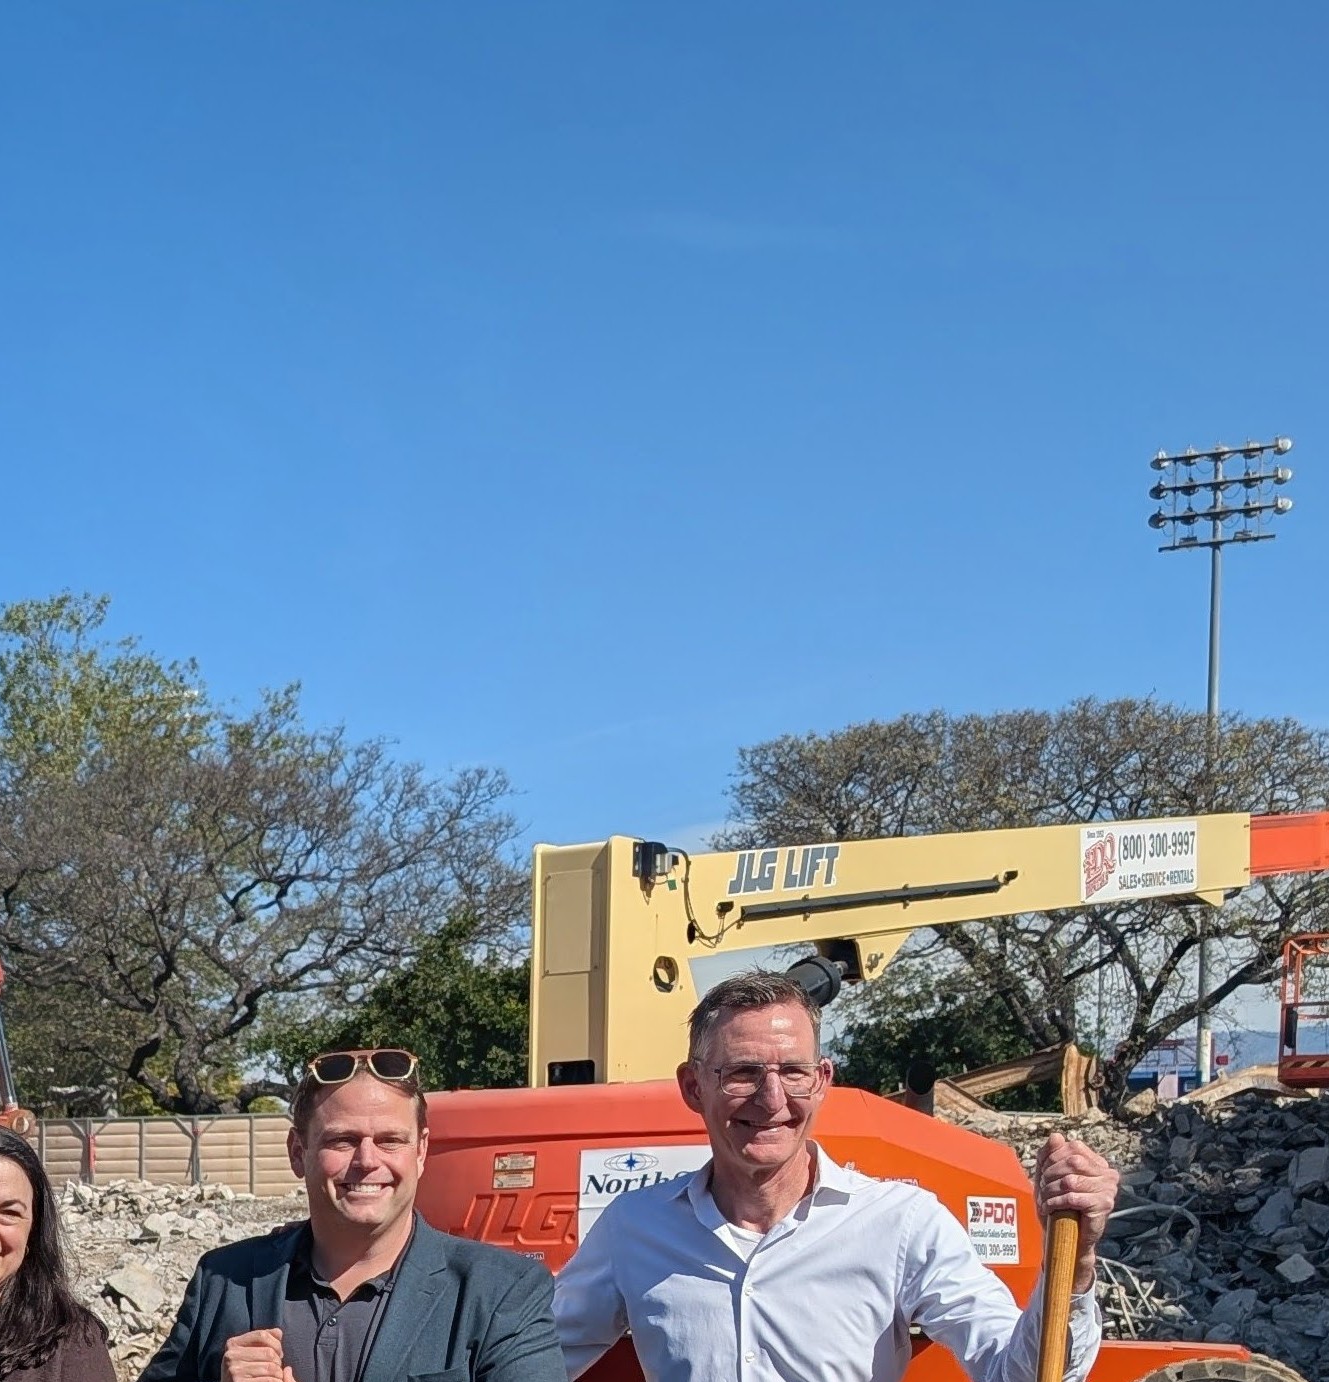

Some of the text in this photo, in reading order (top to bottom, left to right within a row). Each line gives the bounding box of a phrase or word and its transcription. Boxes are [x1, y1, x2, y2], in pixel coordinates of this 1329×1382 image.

[1118, 830, 1196, 867] (800) 300-9997
[727, 845, 840, 895] JLG LIFT
[582, 1171, 689, 1195] North
[983, 1202, 1015, 1226] PDQ
